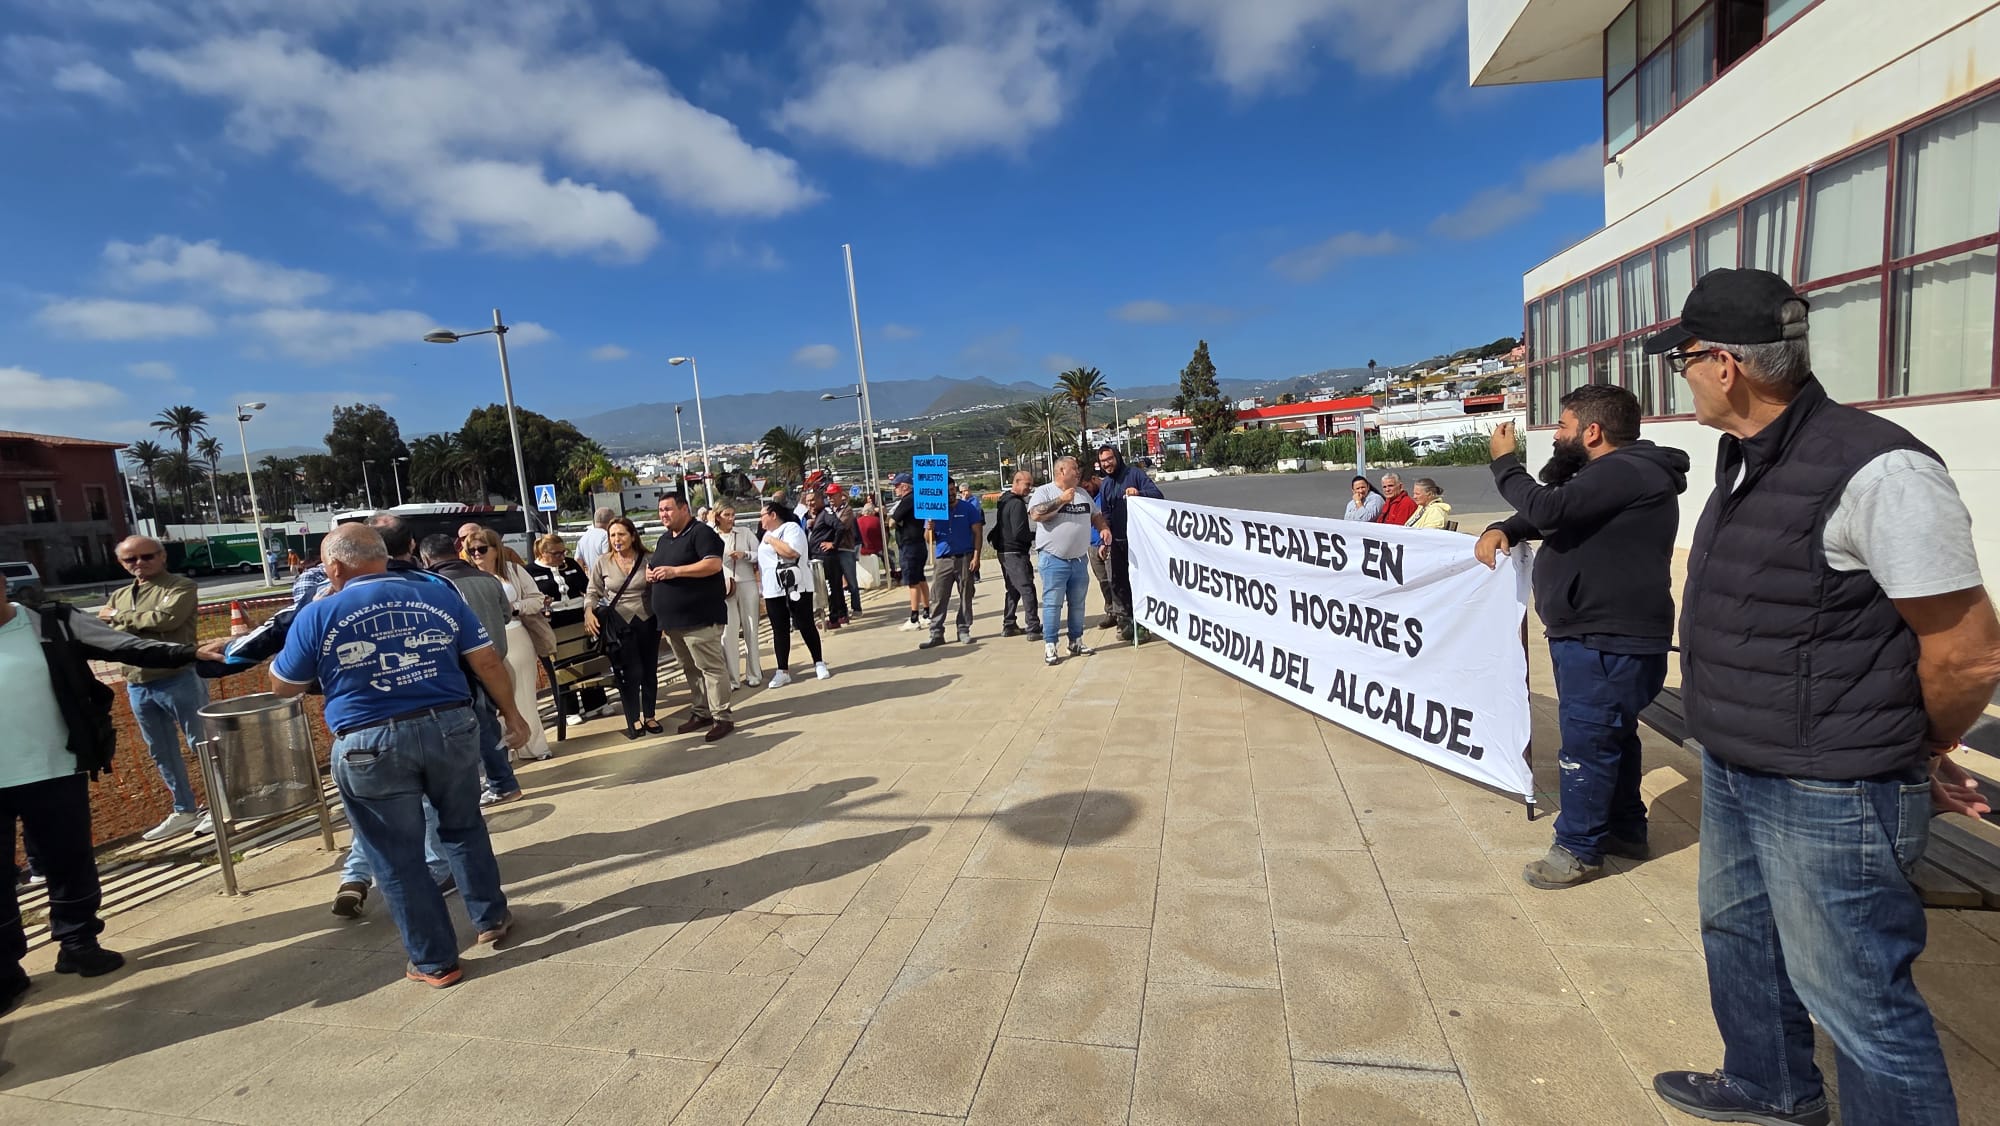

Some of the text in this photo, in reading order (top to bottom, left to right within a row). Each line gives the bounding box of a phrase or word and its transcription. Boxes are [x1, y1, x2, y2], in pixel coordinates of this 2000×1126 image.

[937, 459, 947, 467] LOS
[1165, 508, 1404, 586] AGUAS FECALES EN
[322, 627, 340, 657] YERAY
[1169, 557, 1423, 658] NUESTROS HOGARES
[1144, 595, 1484, 761] POR DESIDIA DEL ALCALDE.
